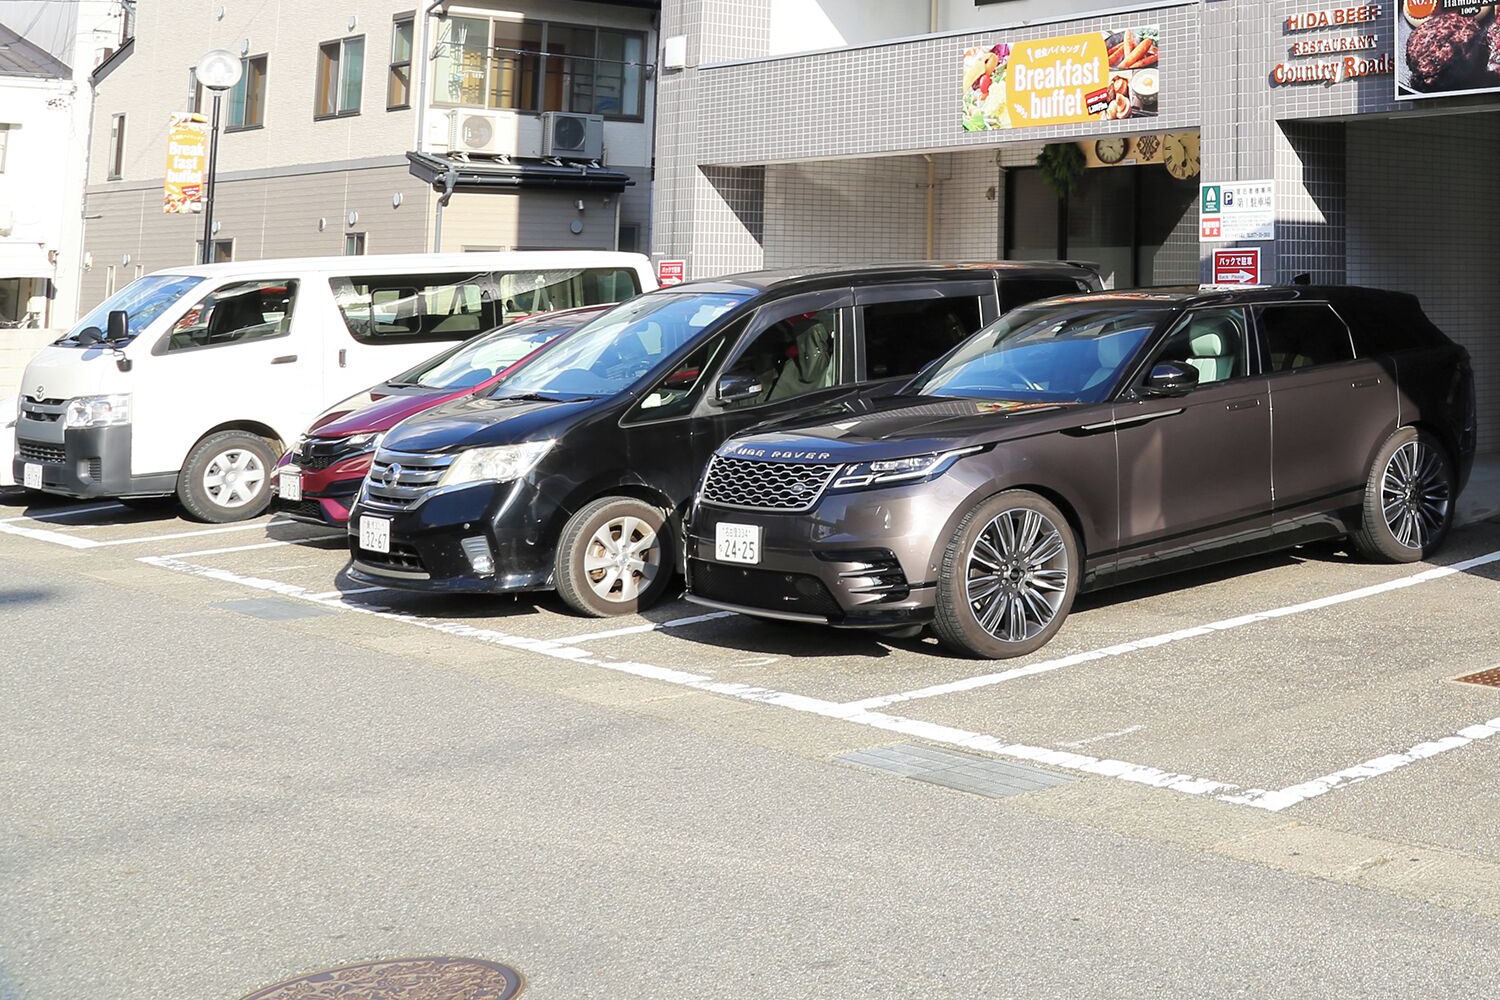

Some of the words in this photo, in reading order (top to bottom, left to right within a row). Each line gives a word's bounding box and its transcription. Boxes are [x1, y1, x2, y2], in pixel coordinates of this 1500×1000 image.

[1287, 11, 1330, 31] HIDA
[1333, 5, 1381, 25] BEEF
[1460, 7, 1479, 15] 100%
[1293, 34, 1378, 56] RESTAURANT
[1014, 56, 1100, 92] Breakfast
[1273, 59, 1341, 83] Country
[1343, 53, 1394, 79] Roads
[1030, 88, 1082, 120] buffet
[1219, 256, 1253, 266] バックで駐車
[771, 450, 830, 460] ROVER
